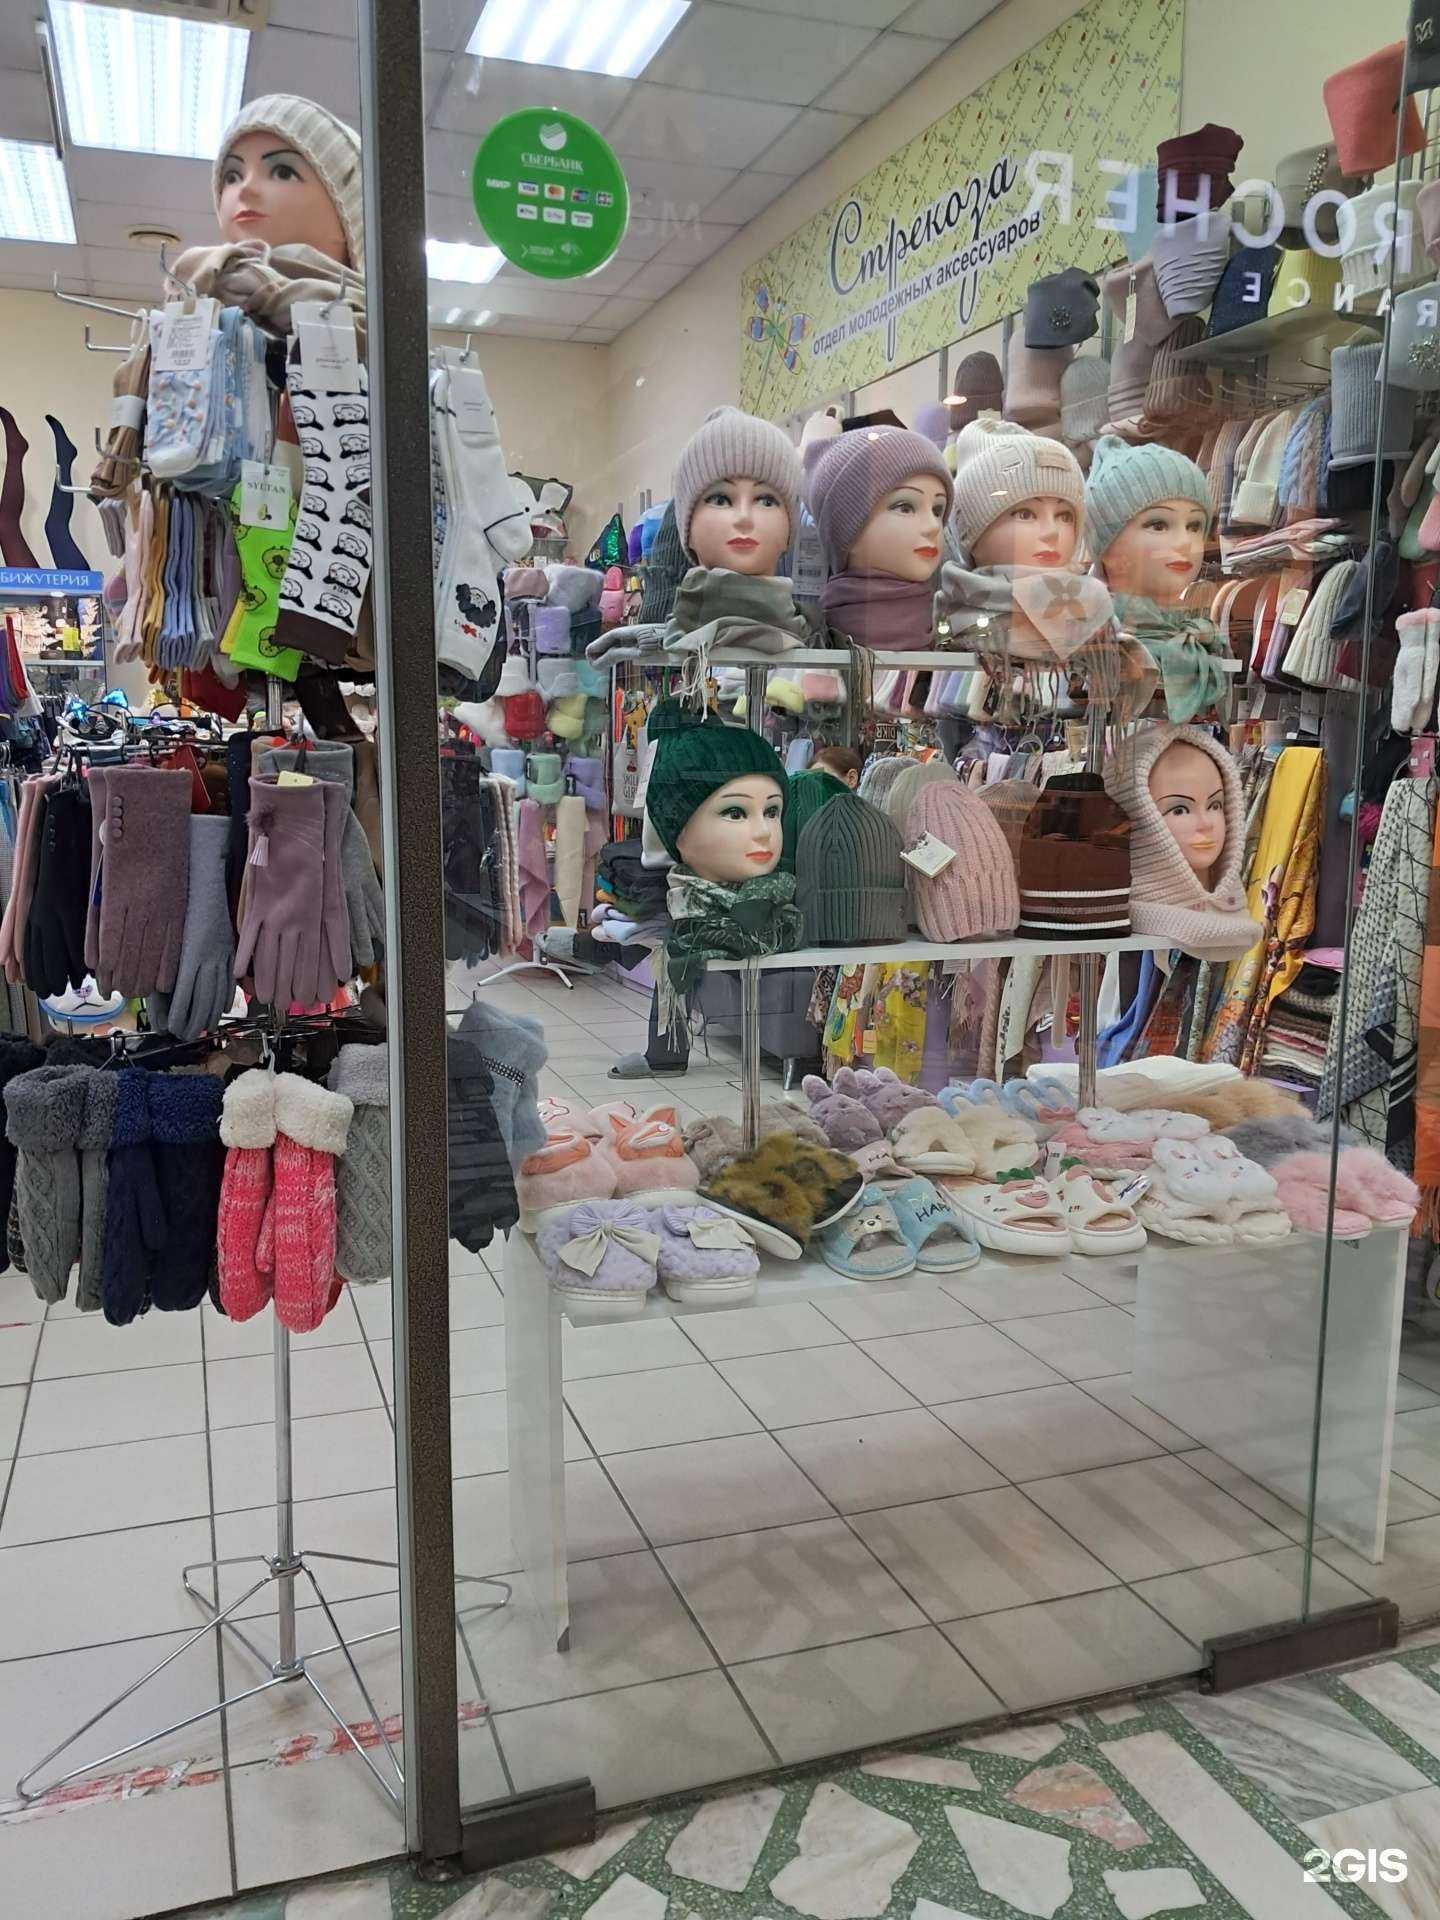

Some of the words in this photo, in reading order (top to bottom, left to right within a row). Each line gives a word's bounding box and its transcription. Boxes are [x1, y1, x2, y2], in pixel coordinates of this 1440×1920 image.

[521, 152, 584, 172] СБЕРБАНК
[813, 328, 846, 355] отдел
[848, 273, 932, 336] молодежных
[936, 211, 1040, 286] аксессуаров
[831, 158, 1018, 362] Стрекоза
[1, 571, 89, 586] БИЖУТЕРИЯ
